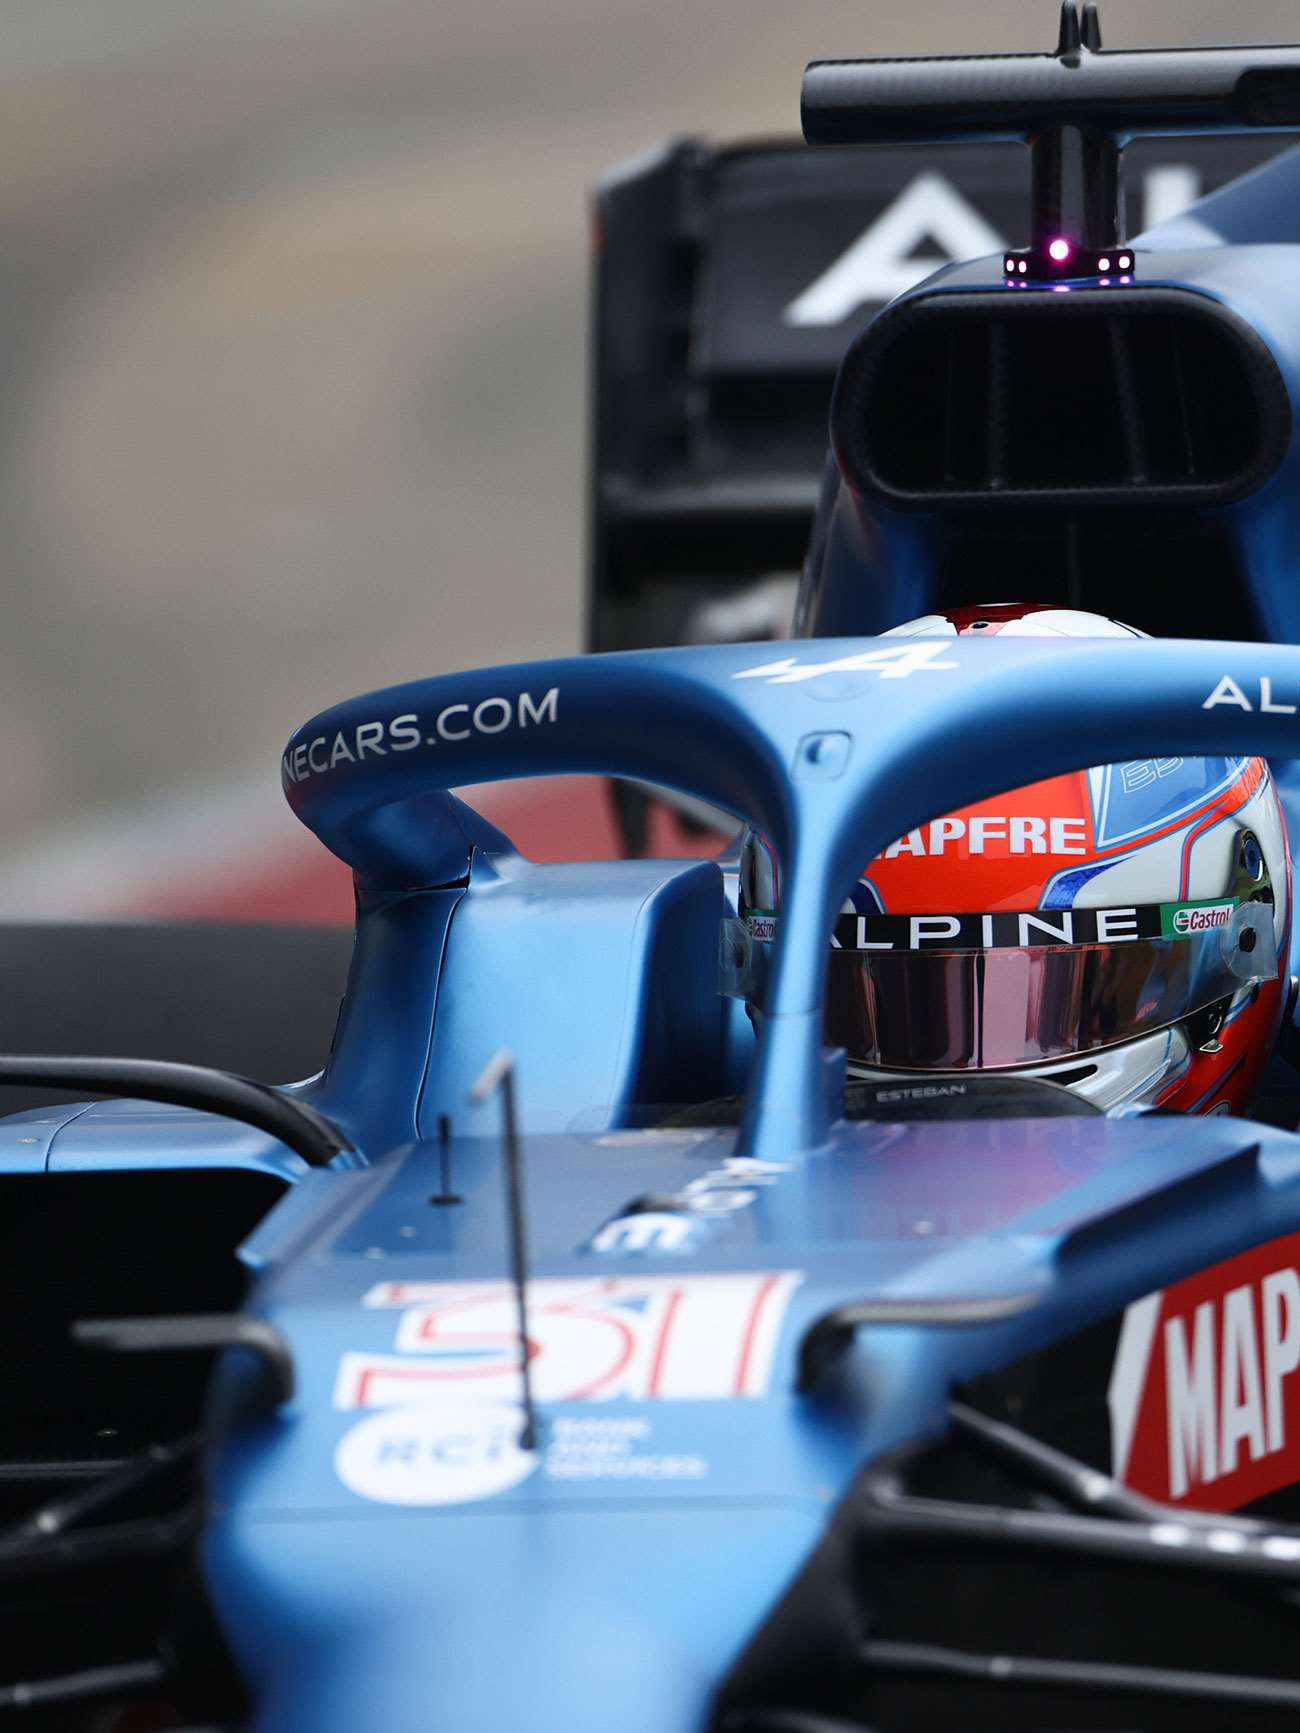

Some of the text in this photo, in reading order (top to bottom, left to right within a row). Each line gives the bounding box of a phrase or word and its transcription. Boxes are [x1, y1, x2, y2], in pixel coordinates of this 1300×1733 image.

[874, 816, 1087, 860] APFRE
[831, 908, 1139, 950] LPINE
[1190, 907, 1230, 930] Castrol
[876, 1084, 967, 1103] ESTEBAN
